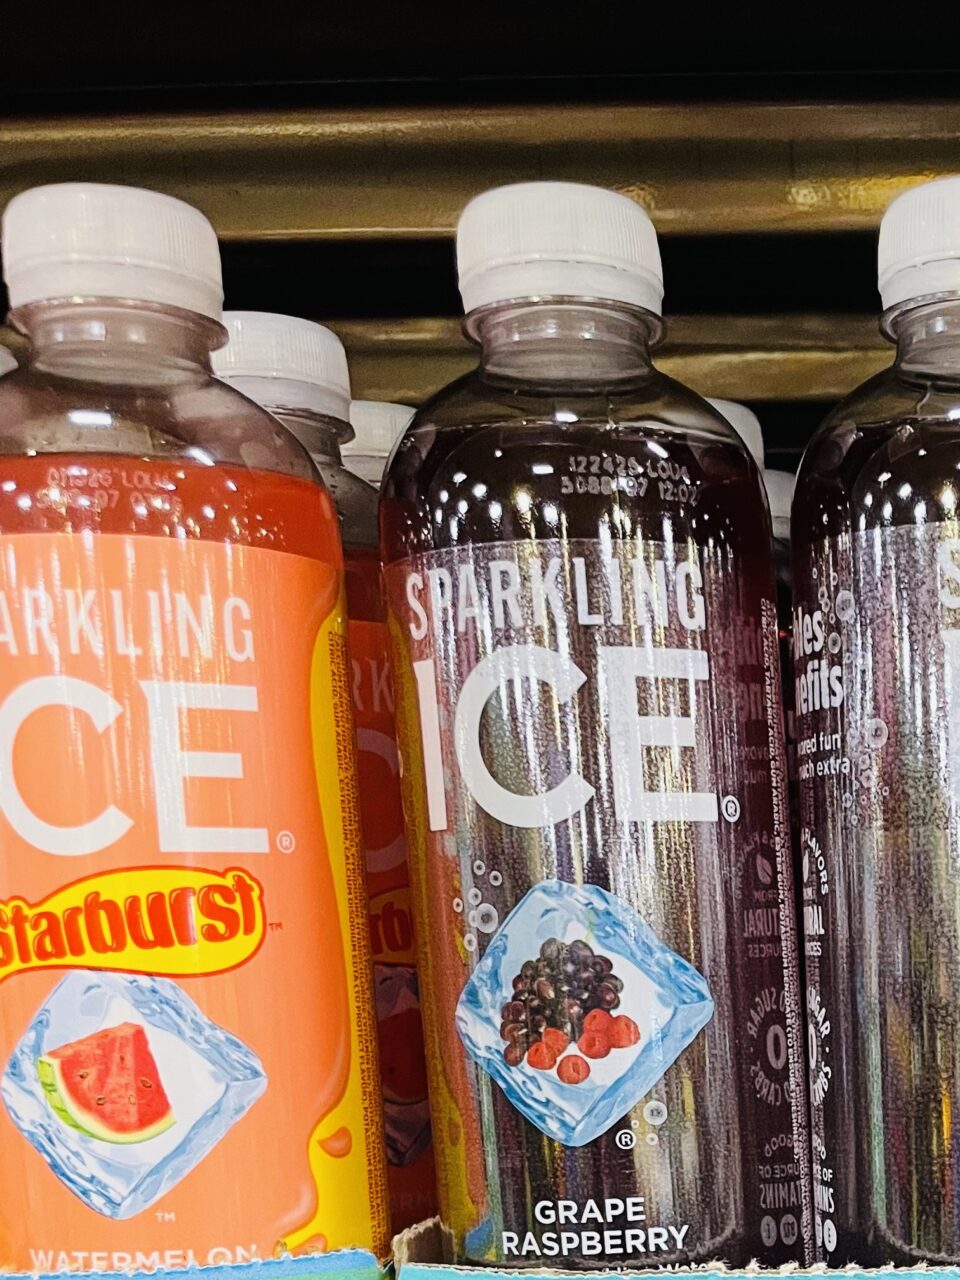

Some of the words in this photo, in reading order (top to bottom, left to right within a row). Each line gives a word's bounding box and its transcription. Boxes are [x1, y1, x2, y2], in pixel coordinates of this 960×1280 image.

[405, 556, 707, 642] SPARKLING
[413, 645, 718, 832] ICE
[534, 1197, 646, 1225] GRAPE
[502, 1225, 689, 1256] RASPBERRY
